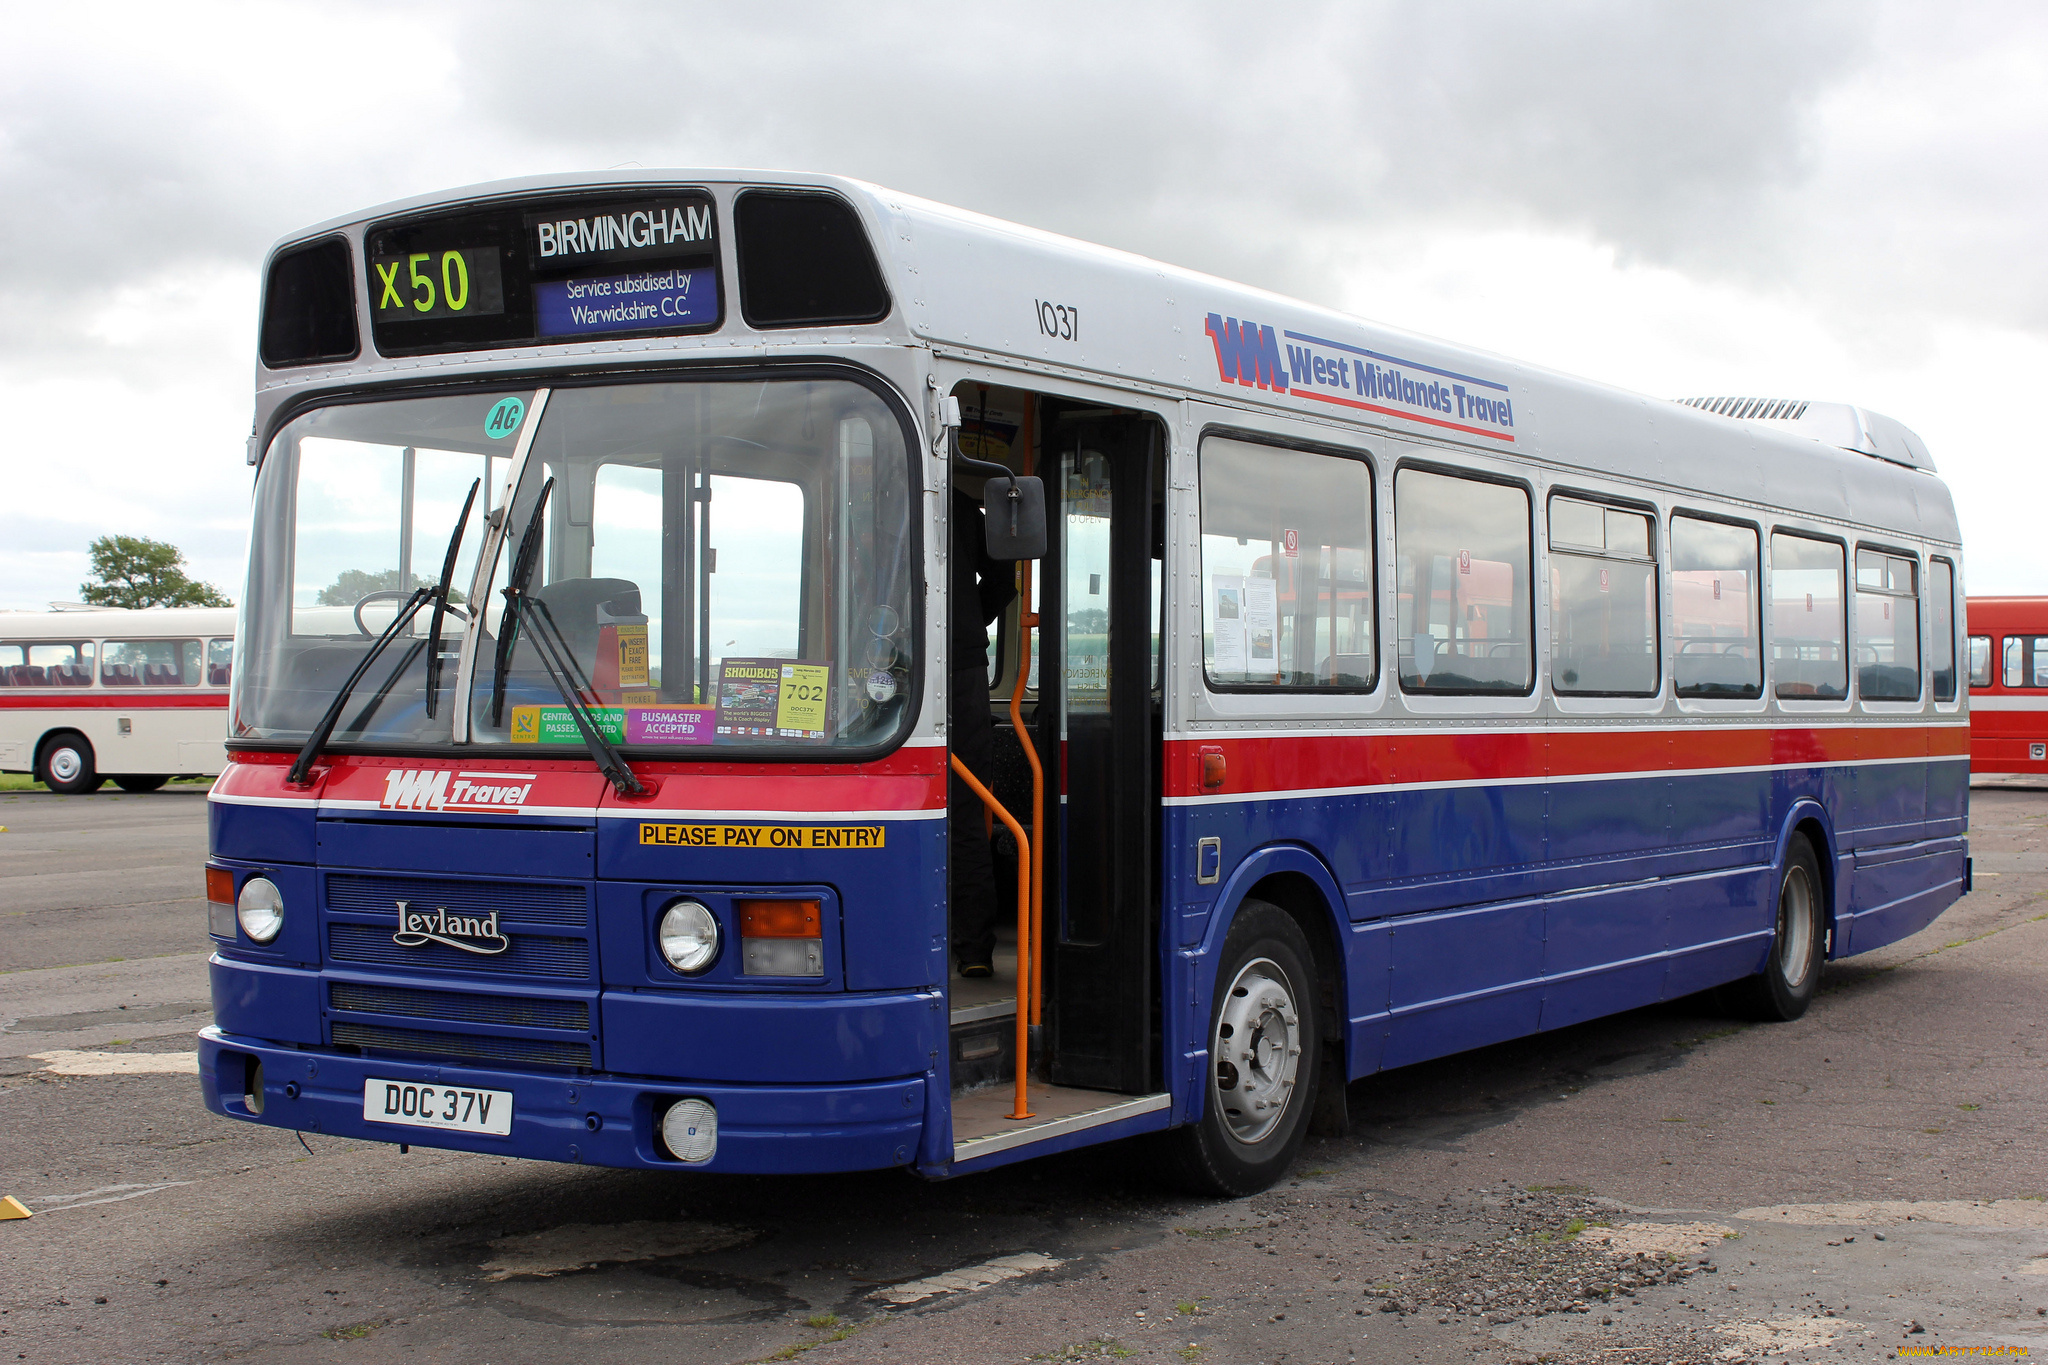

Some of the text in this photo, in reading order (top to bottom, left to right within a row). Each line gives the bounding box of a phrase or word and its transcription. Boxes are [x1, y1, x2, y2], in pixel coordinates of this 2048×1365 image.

[538, 204, 713, 258] BIRMINGHAM
[376, 249, 469, 312] X50
[566, 269, 692, 299] Service subsidised by
[570, 295, 691, 325] Warwickshire C.C.
[1035, 298, 1078, 342] 1037
[1286, 343, 1350, 389] West
[1353, 359, 1452, 414] Midlands
[1452, 383, 1514, 428] Travel
[489, 404, 520, 430] AG
[1060, 489, 1113, 499] EMERGENCY
[628, 637, 646, 646] INSERT
[628, 647, 645, 655] EXACT
[628, 656, 642, 664] FARE
[724, 667, 779, 679] SHOWBUS
[627, 695, 651, 704] TICKET
[786, 684, 823, 702] 702
[541, 713, 574, 721] CENTRO
[603, 713, 623, 722] AND
[641, 712, 702, 723] BUSMASTER
[545, 723, 575, 733] PASSES
[645, 723, 695, 734] ACCEPTED
[449, 780, 533, 805] Travel
[642, 825, 882, 847] PLEASE PAY ON ENTRY
[393, 900, 506, 945] Leyland
[385, 1084, 493, 1125] DOC 37V
